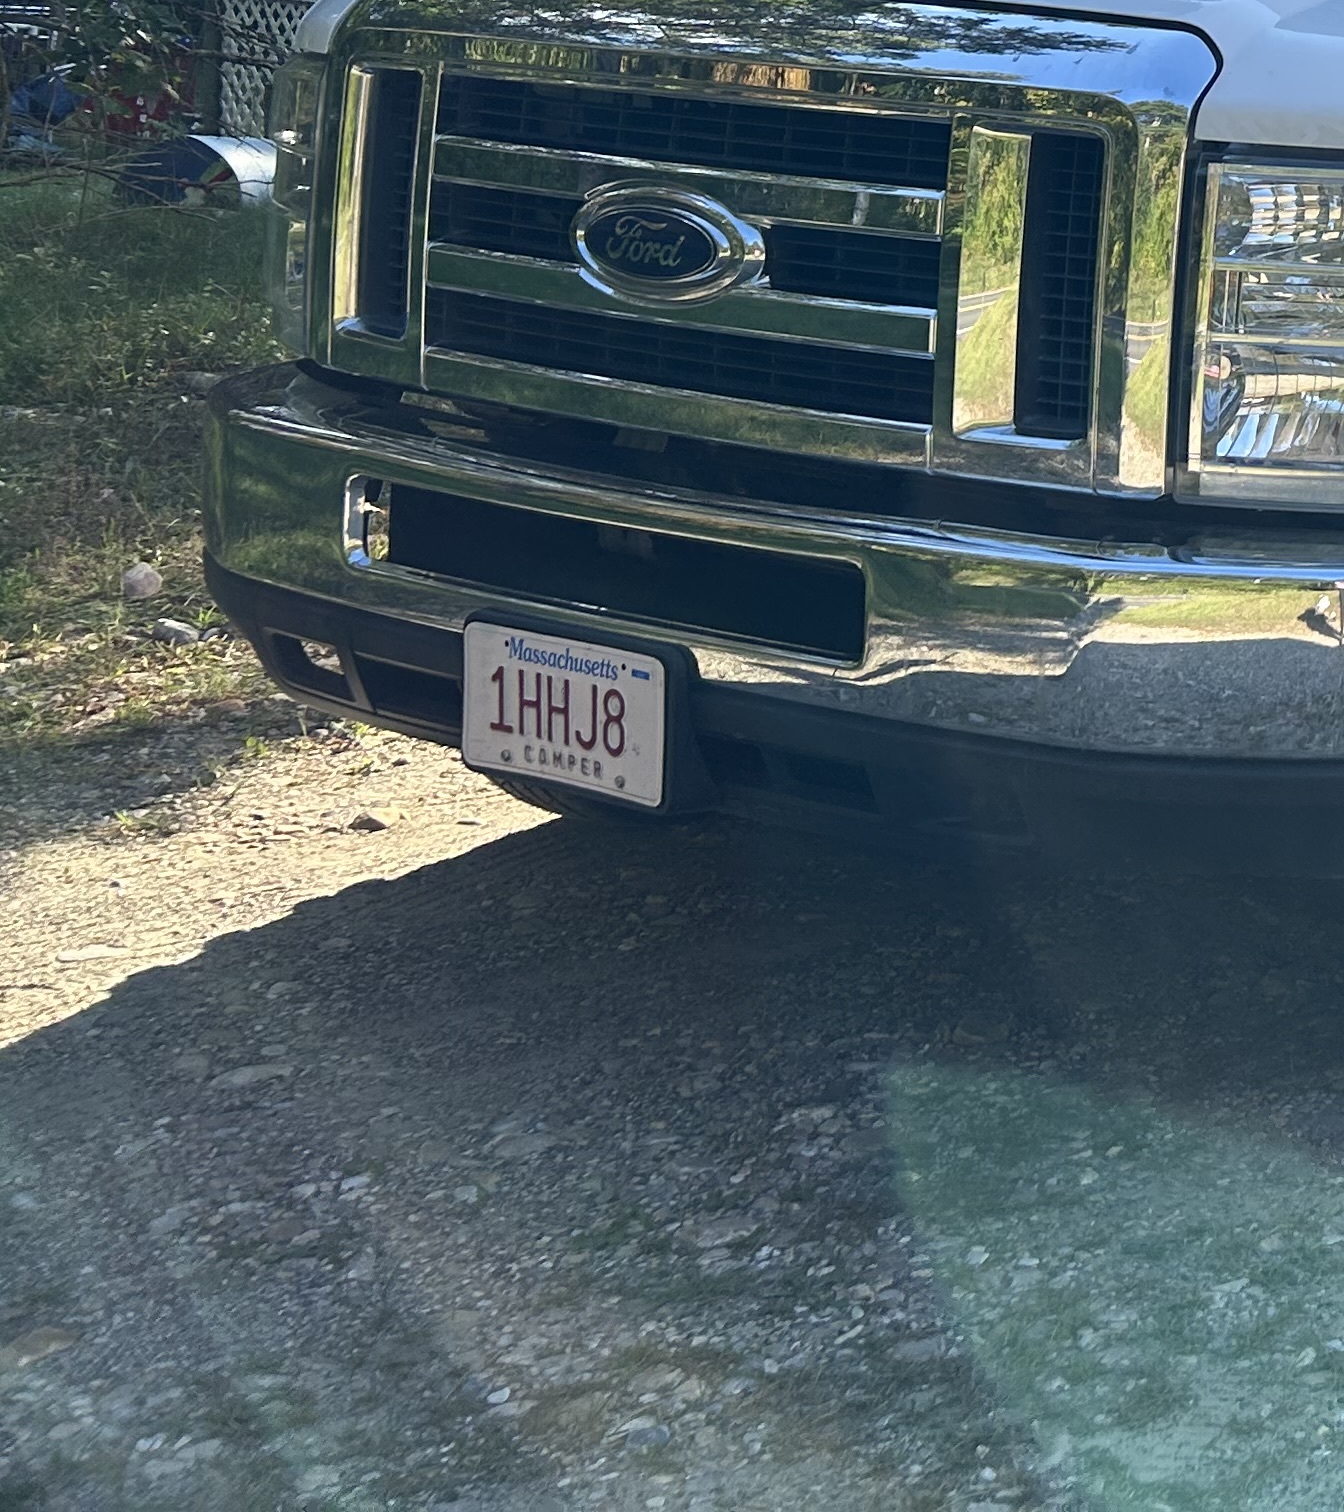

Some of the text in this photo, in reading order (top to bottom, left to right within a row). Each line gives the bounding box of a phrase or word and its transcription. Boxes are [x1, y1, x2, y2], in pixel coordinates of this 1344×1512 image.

[605, 215, 685, 267] Ford
[508, 636, 619, 681] Massachusetts
[490, 665, 625, 758] 1HHJ8
[523, 744, 605, 779] CAMPER
